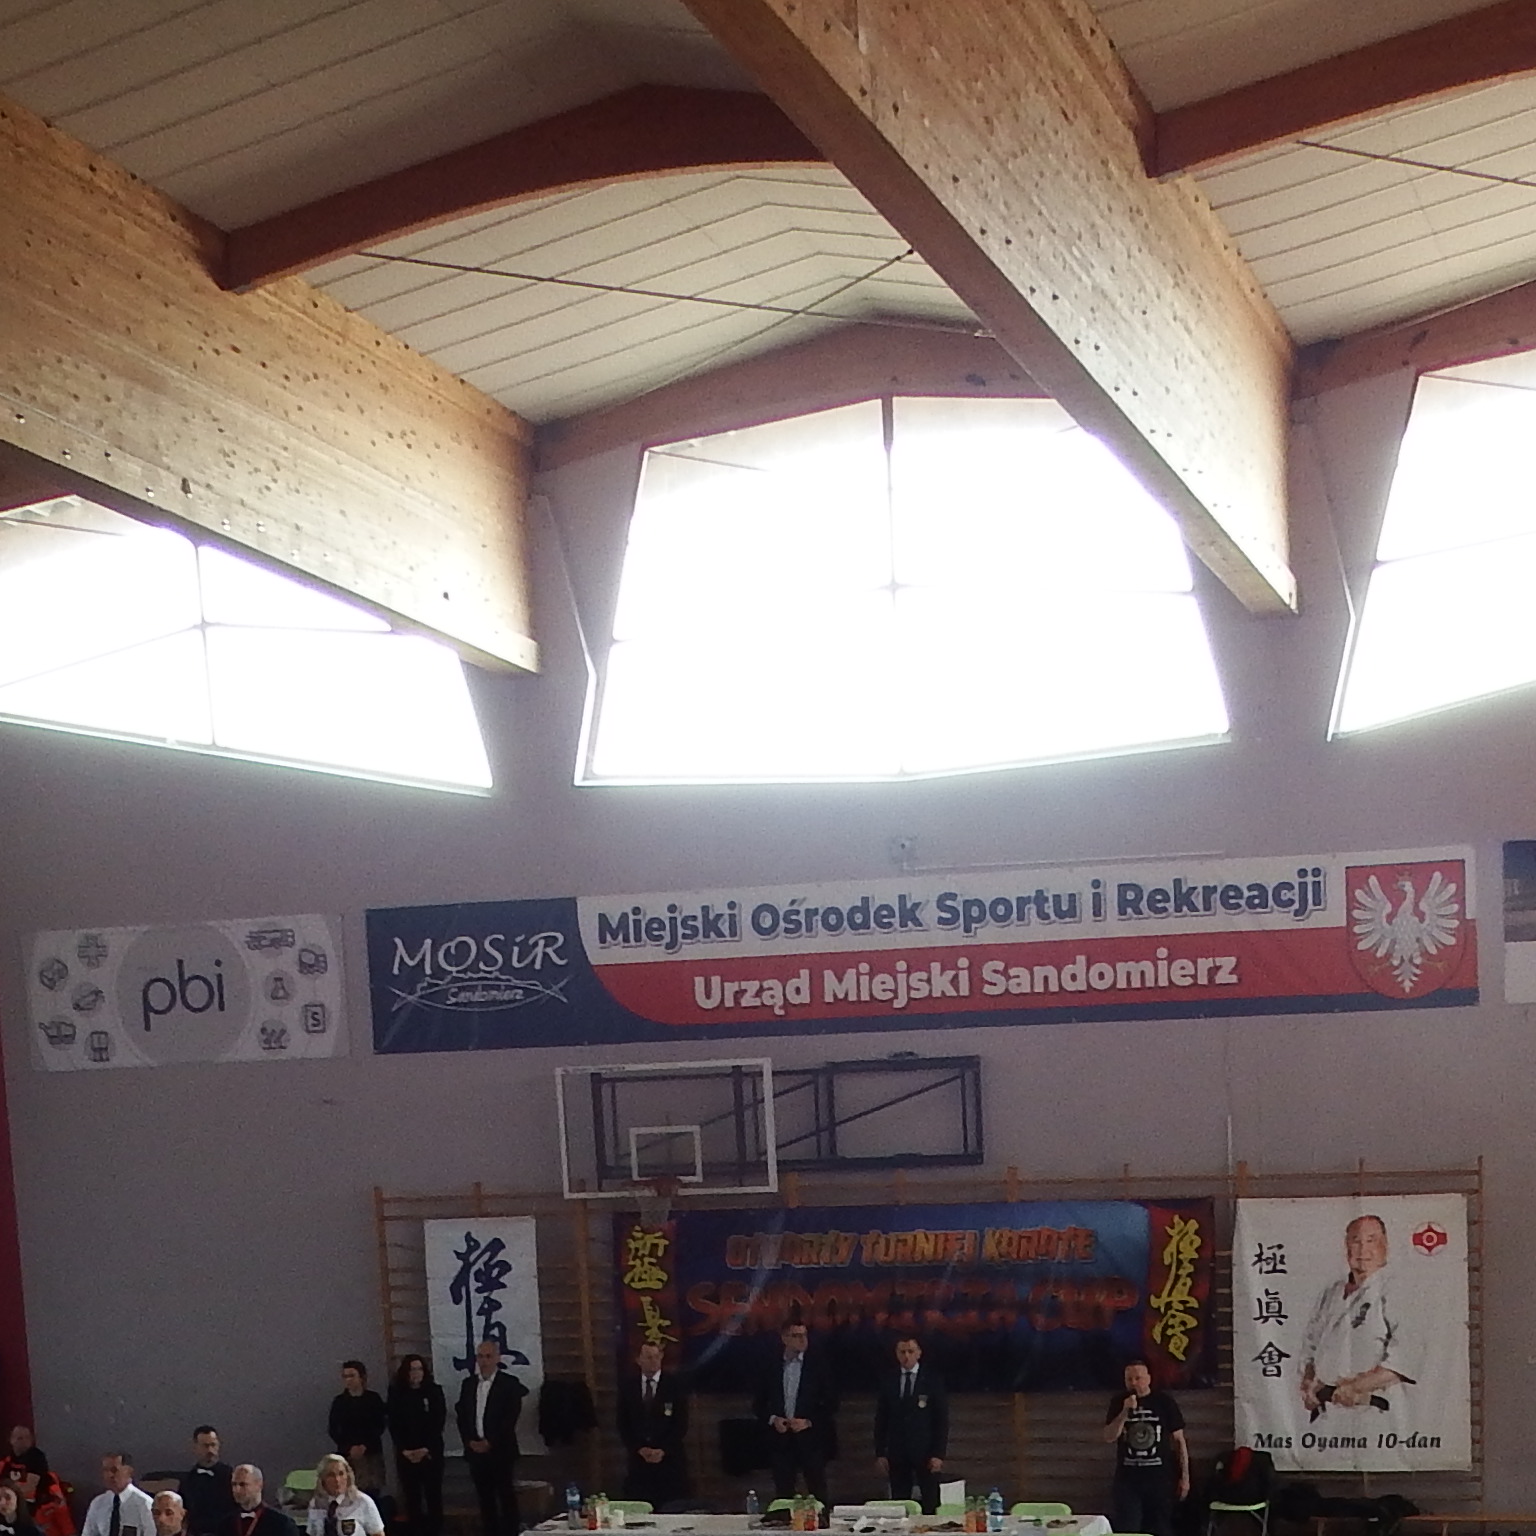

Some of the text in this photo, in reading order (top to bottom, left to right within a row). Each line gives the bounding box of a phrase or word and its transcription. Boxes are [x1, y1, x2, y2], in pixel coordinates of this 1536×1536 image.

[597, 867, 1323, 952] Miejski Ośrodek Sportu i Rekreacji
[391, 931, 569, 976] MOSiR
[693, 947, 1239, 1016] Urząd Miejski Sandomierz
[142, 957, 226, 1032] pbi
[1253, 1430, 1442, 1453] Mas Oyama 10-dan
